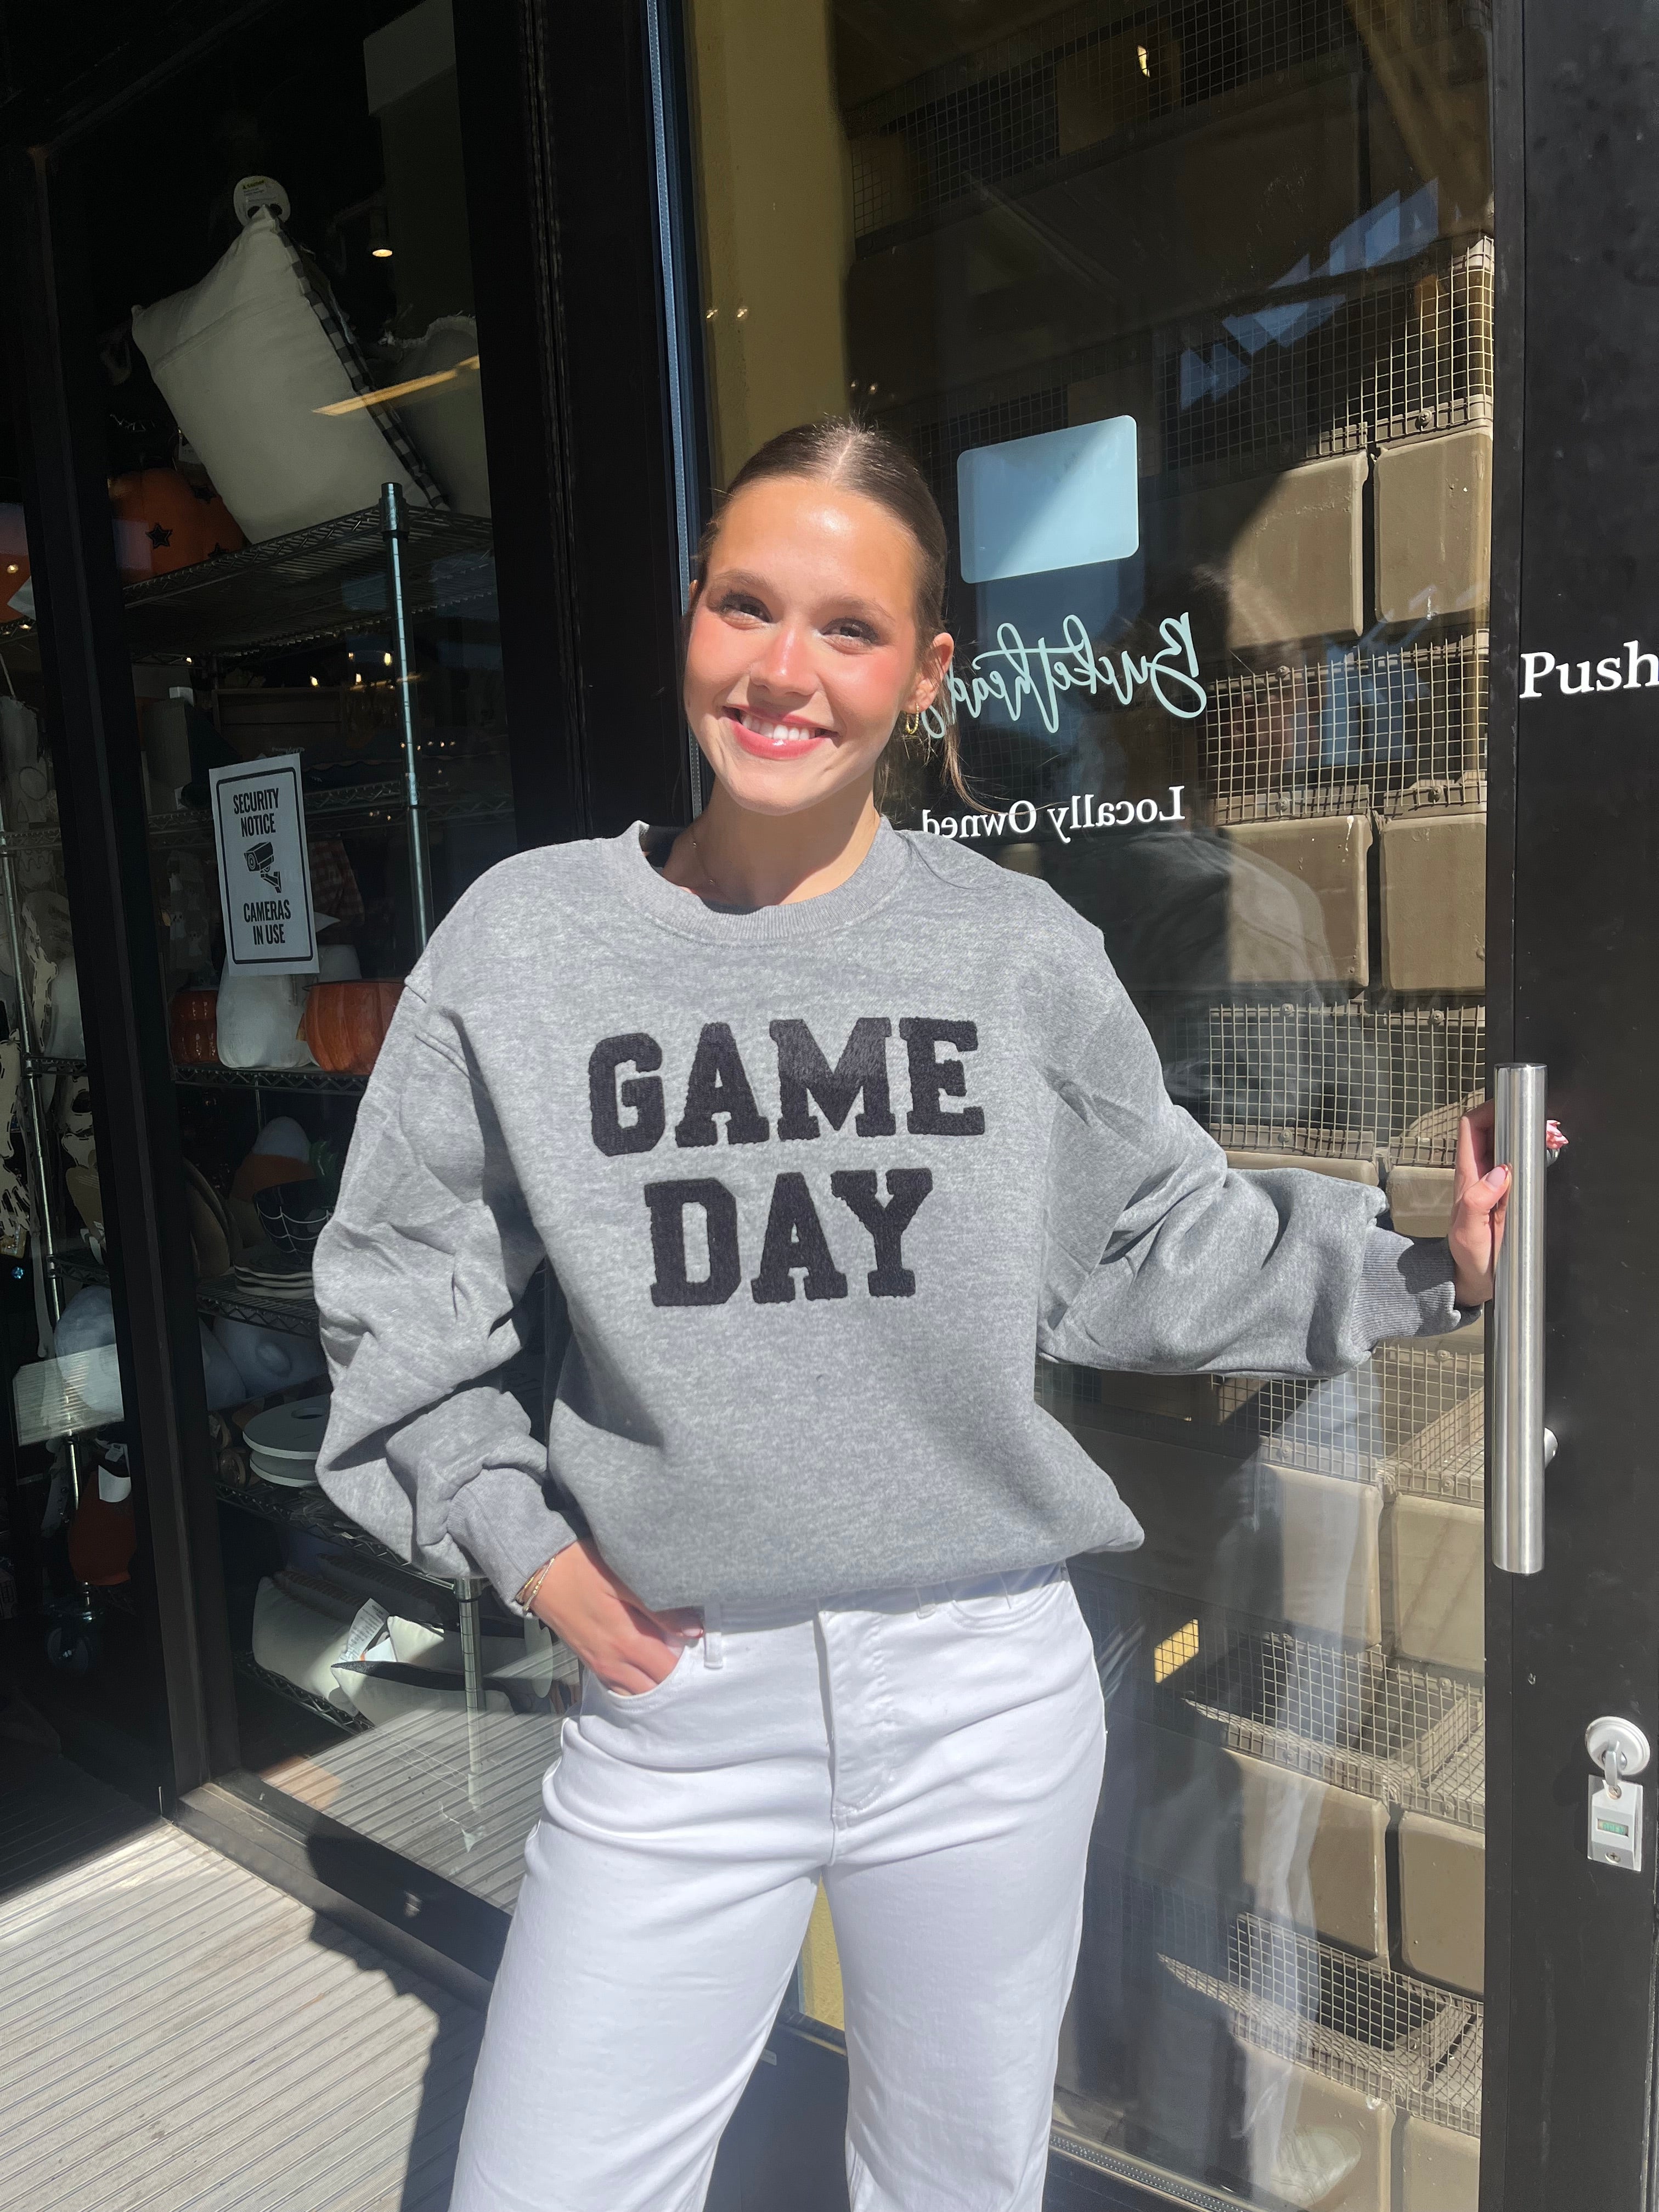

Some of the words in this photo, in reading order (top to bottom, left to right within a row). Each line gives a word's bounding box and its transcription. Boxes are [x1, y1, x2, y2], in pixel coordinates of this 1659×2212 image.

[1519, 640, 1659, 698] Push
[233, 788, 280, 815] SECURITY
[240, 813, 276, 837] NOTICE
[243, 899, 291, 923] CAMERAS
[253, 925, 264, 945] IN
[266, 923, 286, 945] USE
[588, 1017, 985, 1156] GAME
[644, 1167, 933, 1307] DAY
